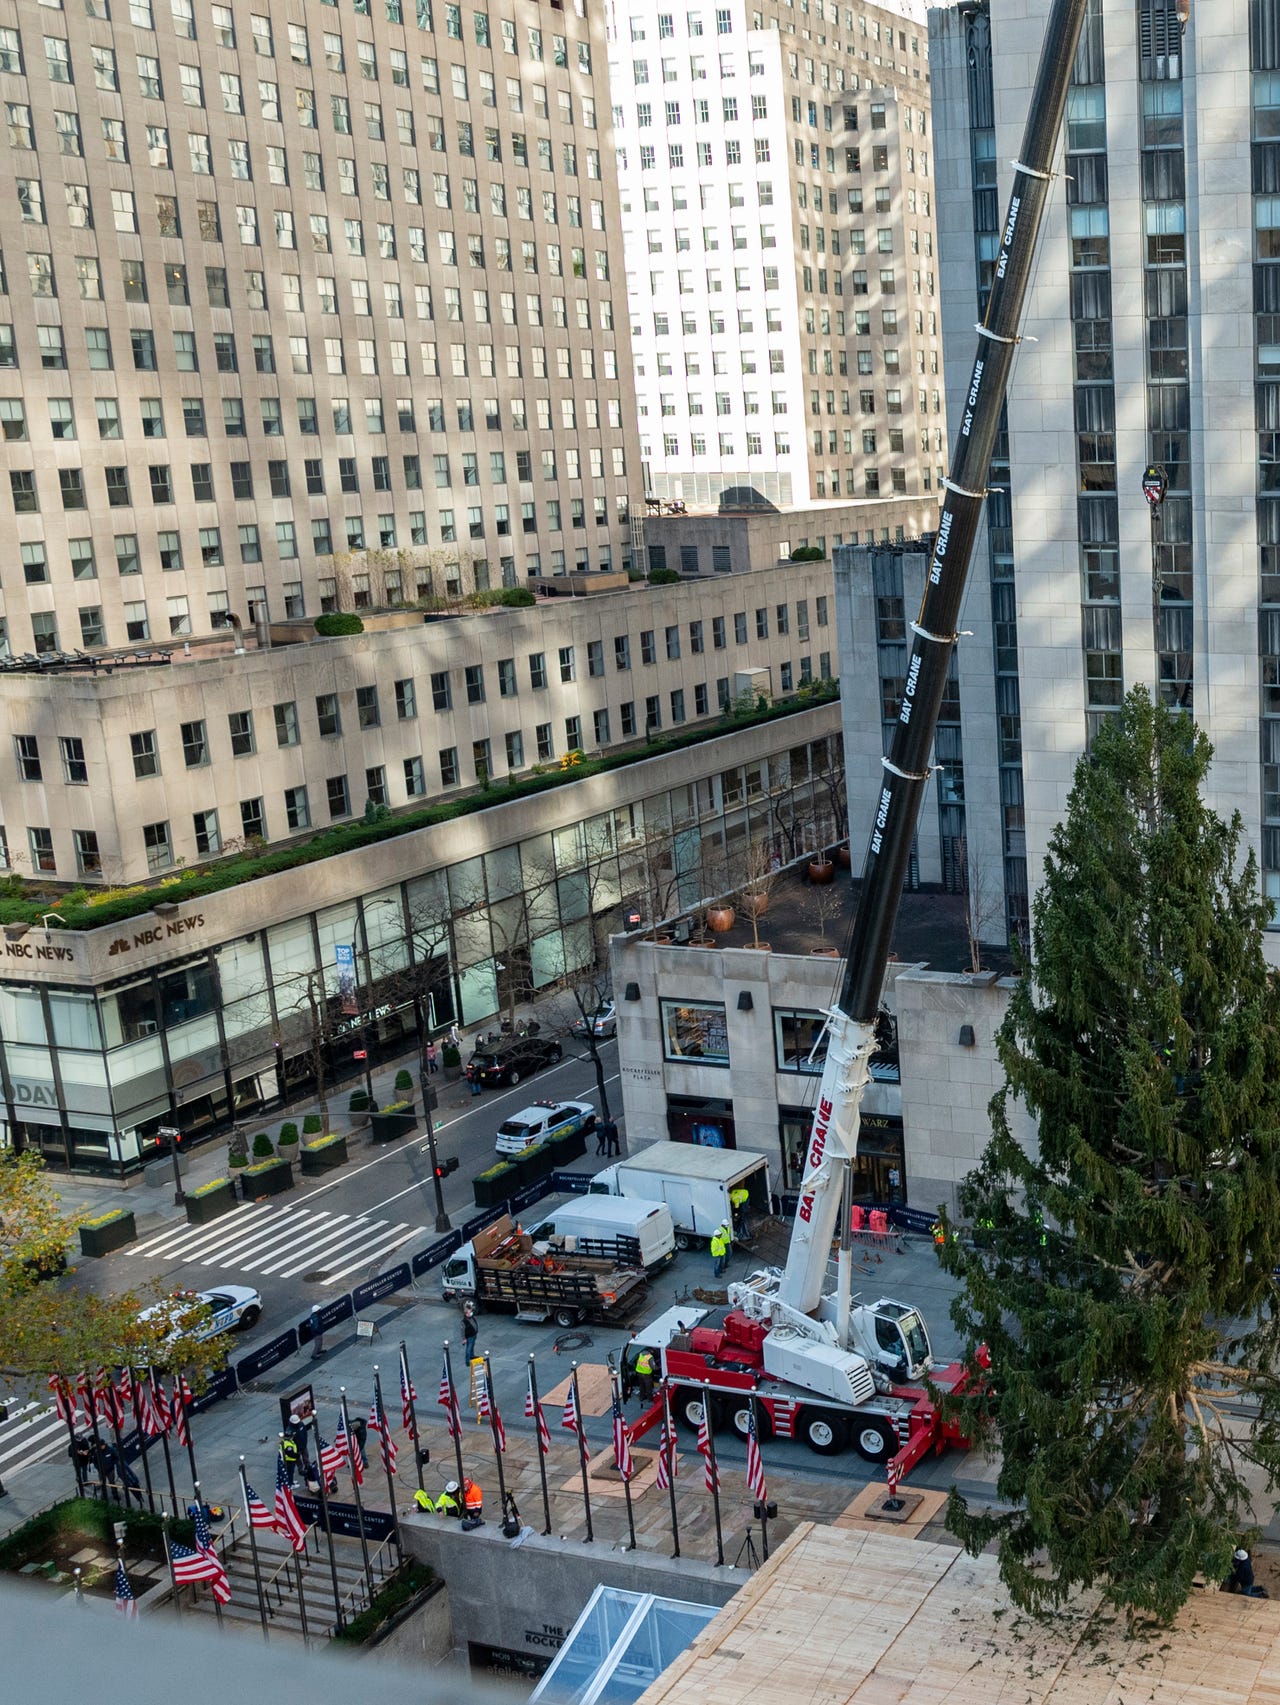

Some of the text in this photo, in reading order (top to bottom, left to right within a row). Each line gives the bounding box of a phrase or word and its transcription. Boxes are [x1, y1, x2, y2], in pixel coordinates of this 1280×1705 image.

[997, 196, 1020, 279] BAY CRANE
[962, 360, 984, 436] BAY CRANE
[930, 511, 953, 585] BAY CRANE
[900, 654, 922, 724] BAY CRANE
[871, 788, 892, 855] BAY CRANE
[6, 943, 74, 962] NBC NEWS
[134, 914, 205, 949] NBC NEWS
[1, 1082, 58, 1106] ODAY
[862, 1117, 889, 1128] WARZ
[799, 1096, 833, 1223] BA CRANE
[543, 1624, 564, 1637] THE
